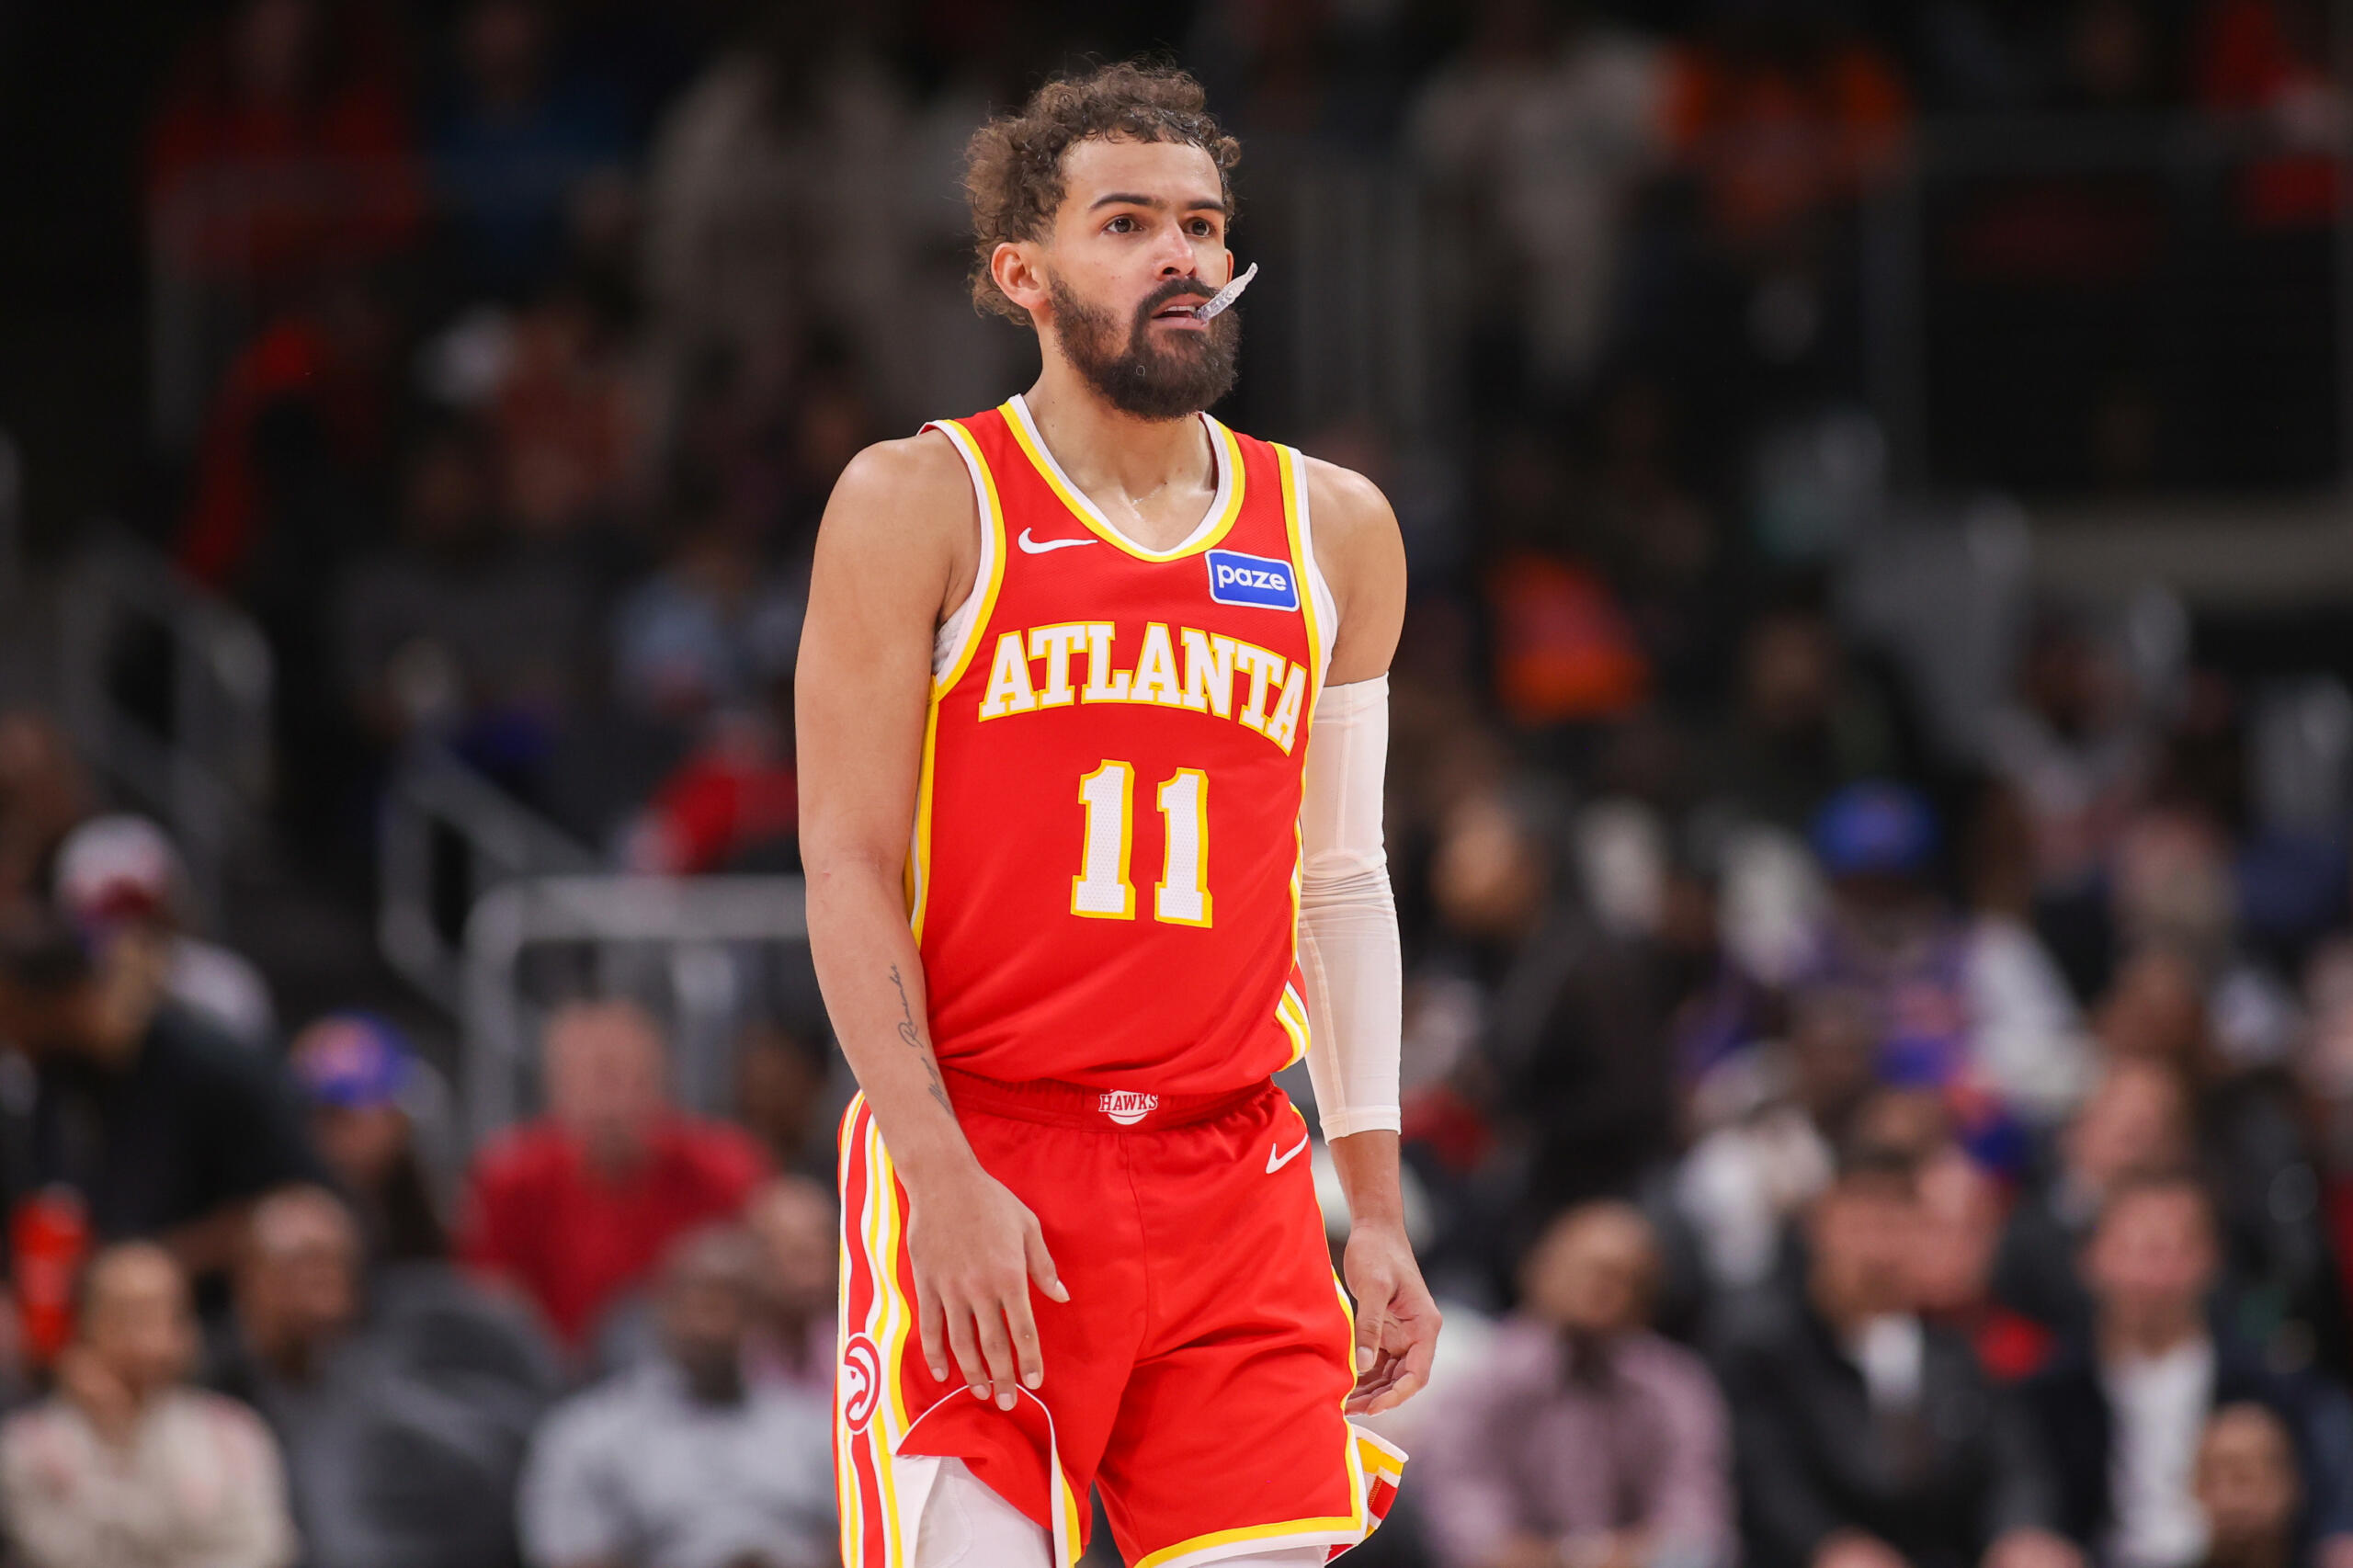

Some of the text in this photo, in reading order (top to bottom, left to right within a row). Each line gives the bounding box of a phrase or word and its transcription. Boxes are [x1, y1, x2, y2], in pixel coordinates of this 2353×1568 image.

[1216, 564, 1287, 591] paze
[978, 621, 1307, 756] ATLANTA
[1070, 759, 1212, 928] 11
[1099, 1094, 1158, 1111] HAWKS
